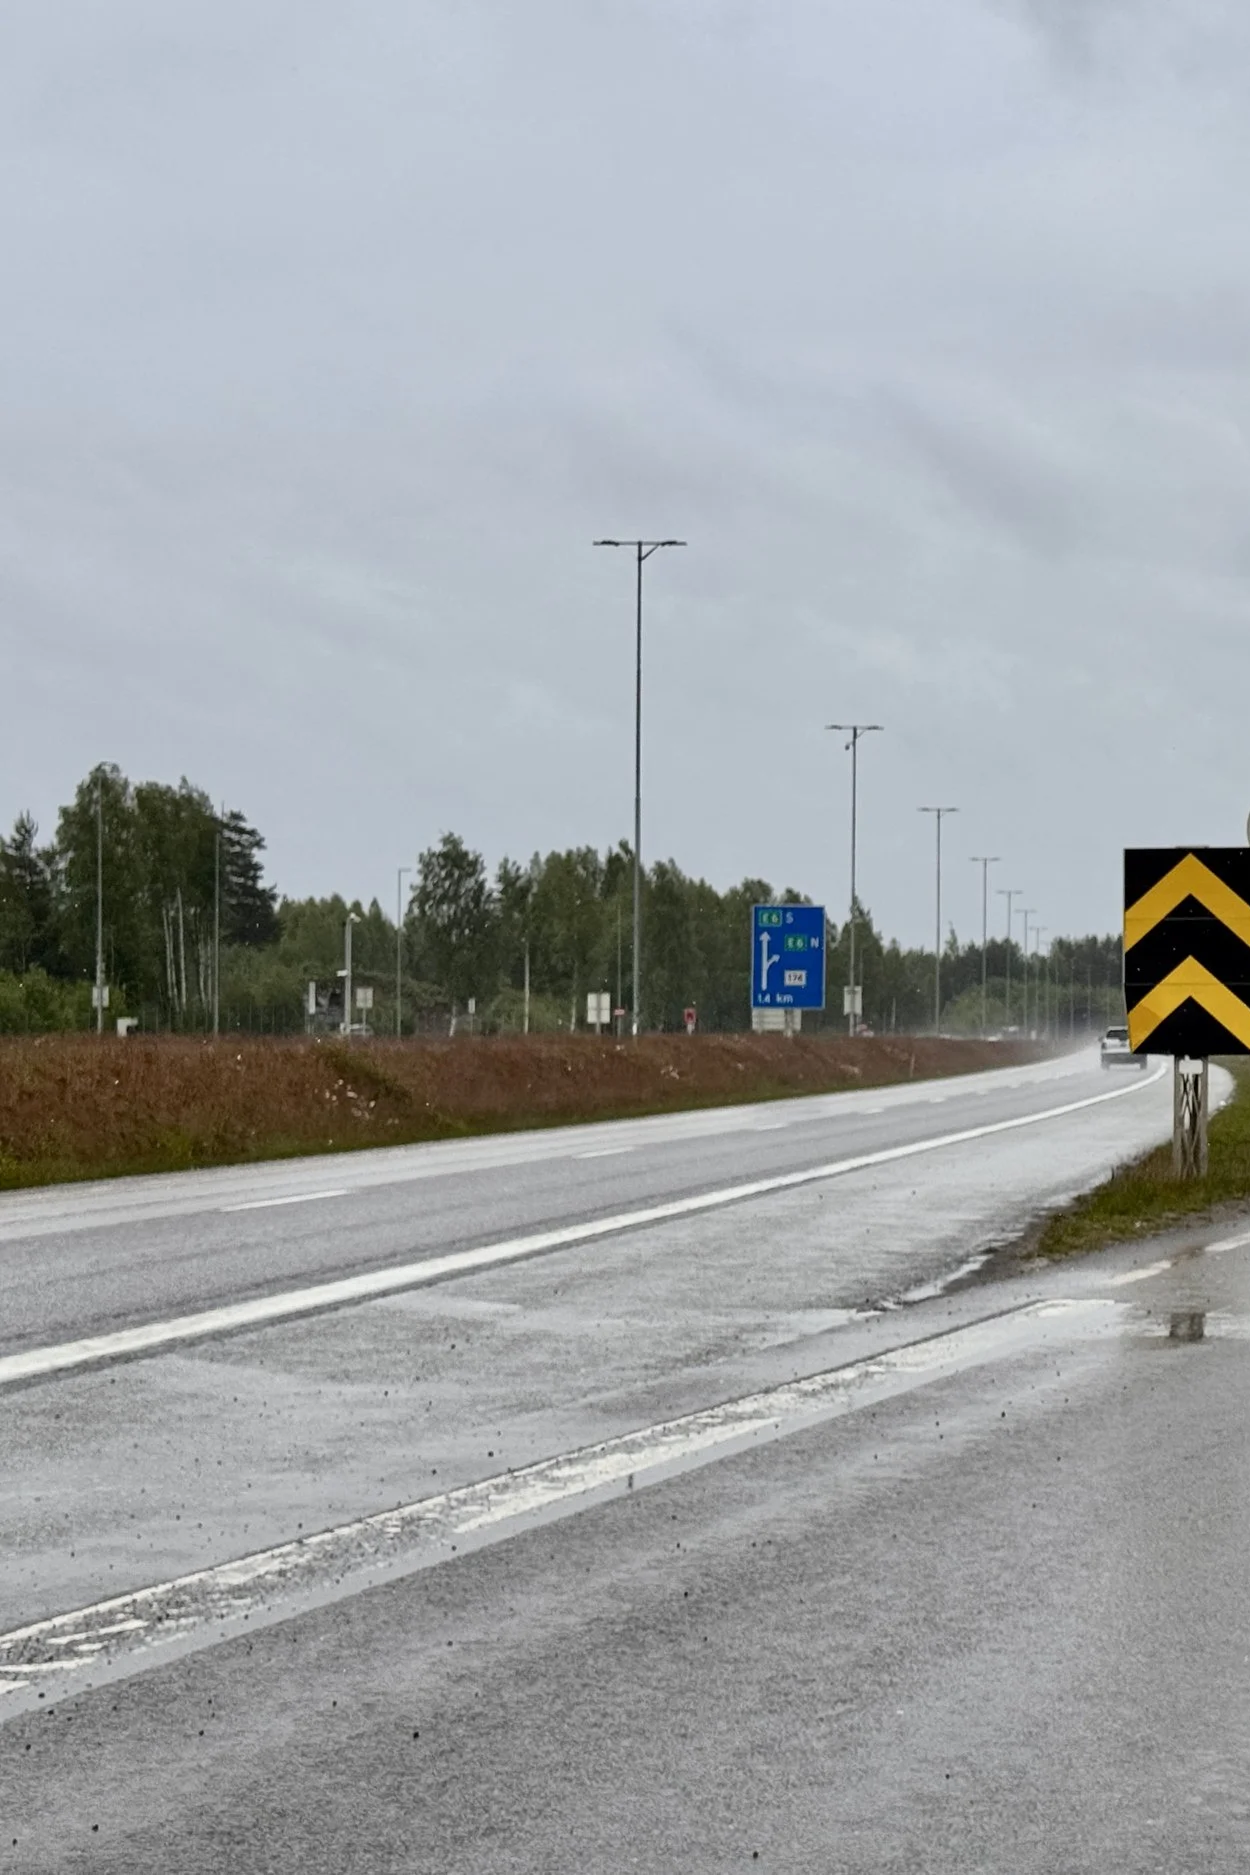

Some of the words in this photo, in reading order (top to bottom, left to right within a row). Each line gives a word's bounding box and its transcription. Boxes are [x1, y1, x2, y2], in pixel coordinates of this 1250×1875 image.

[762, 912, 778, 923] E6
[785, 912, 794, 924] S
[787, 937, 804, 948] E6
[810, 937, 819, 948] N
[776, 993, 794, 1004] km
